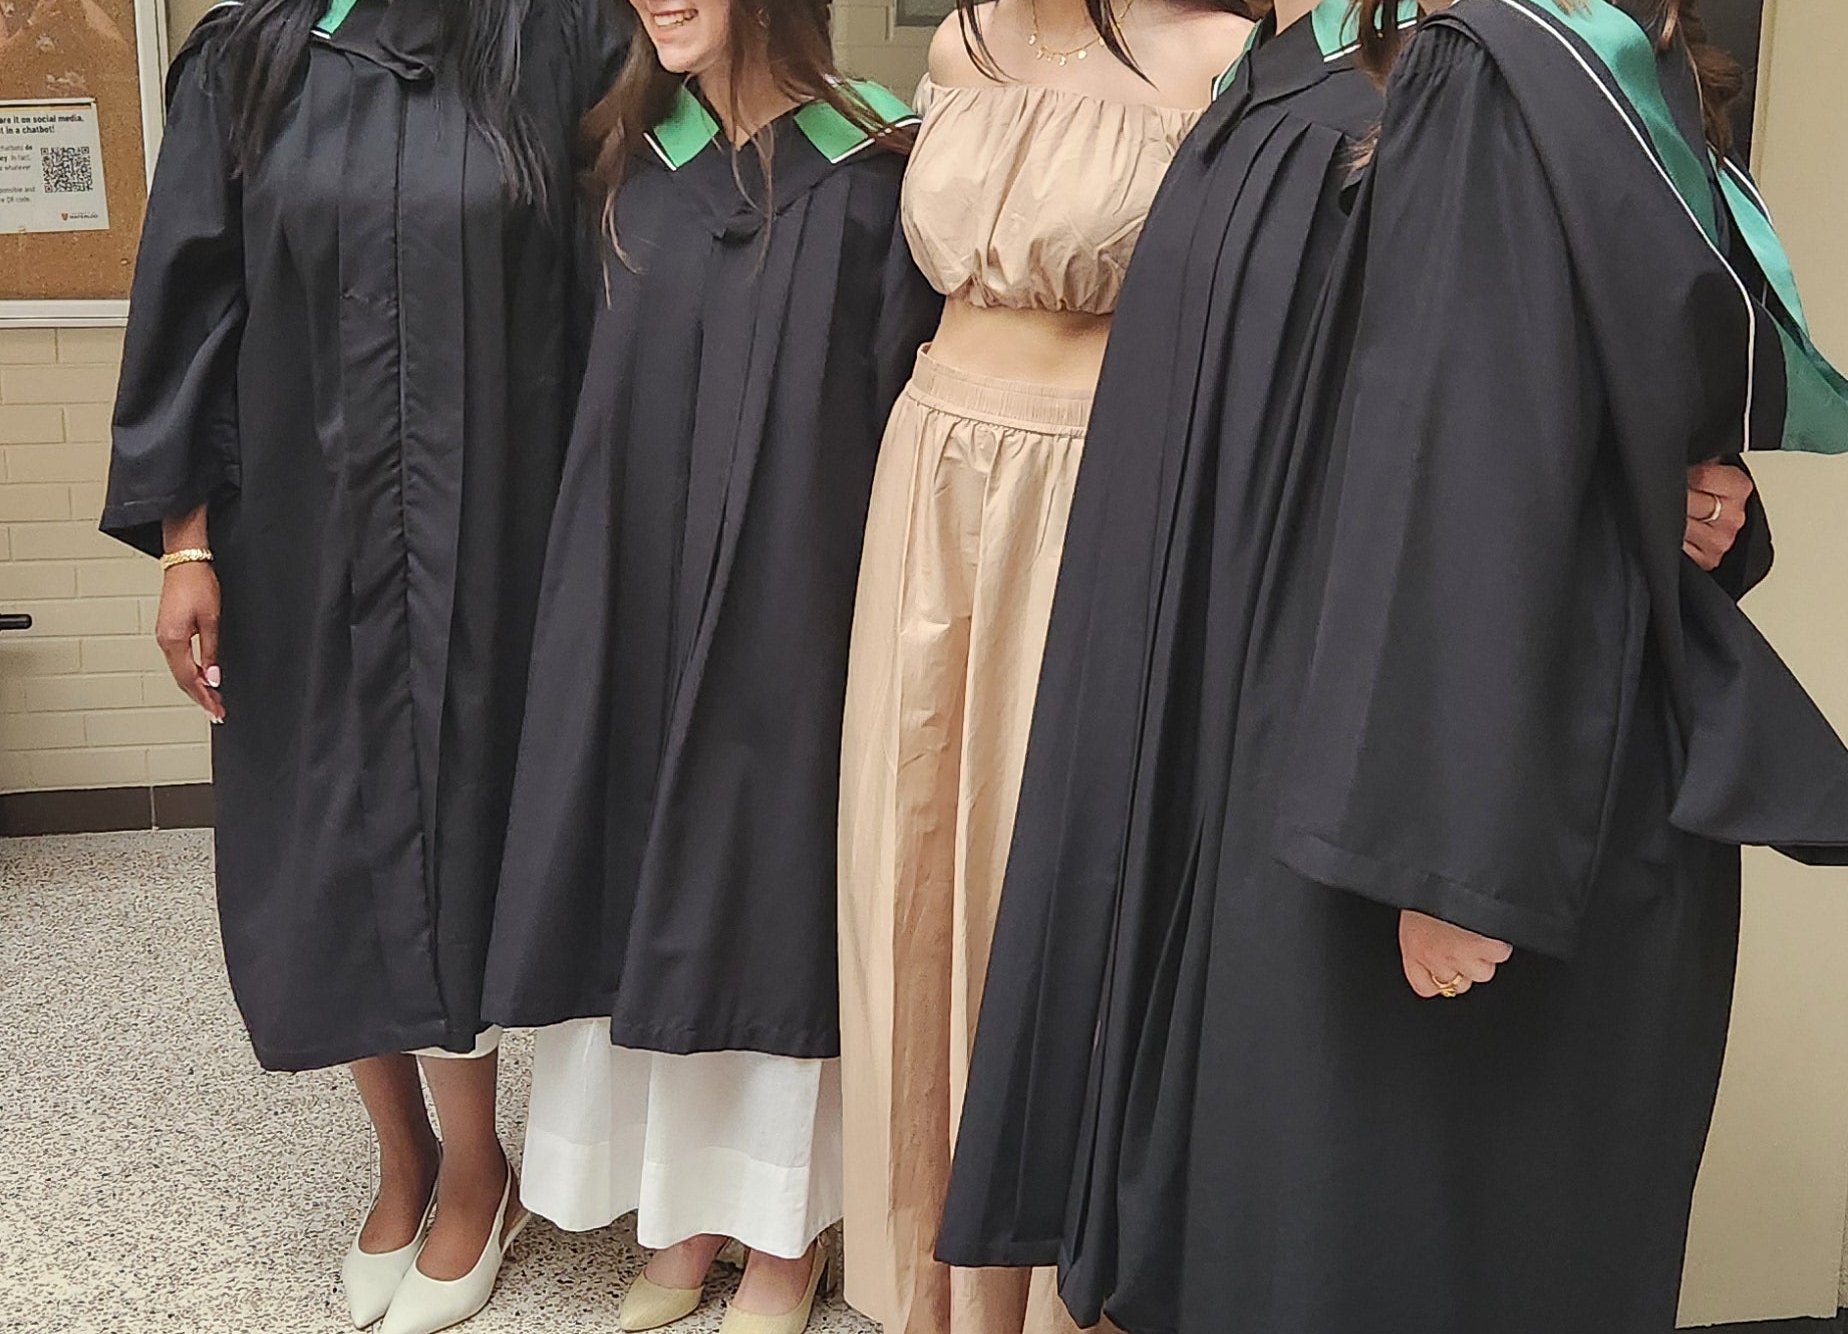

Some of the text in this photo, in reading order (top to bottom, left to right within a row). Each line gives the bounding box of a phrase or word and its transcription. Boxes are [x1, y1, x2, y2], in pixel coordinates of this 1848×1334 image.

[13, 115, 19, 124] it
[33, 115, 56, 124] social
[6, 126, 13, 134] in
[22, 125, 55, 134] chatbot!
